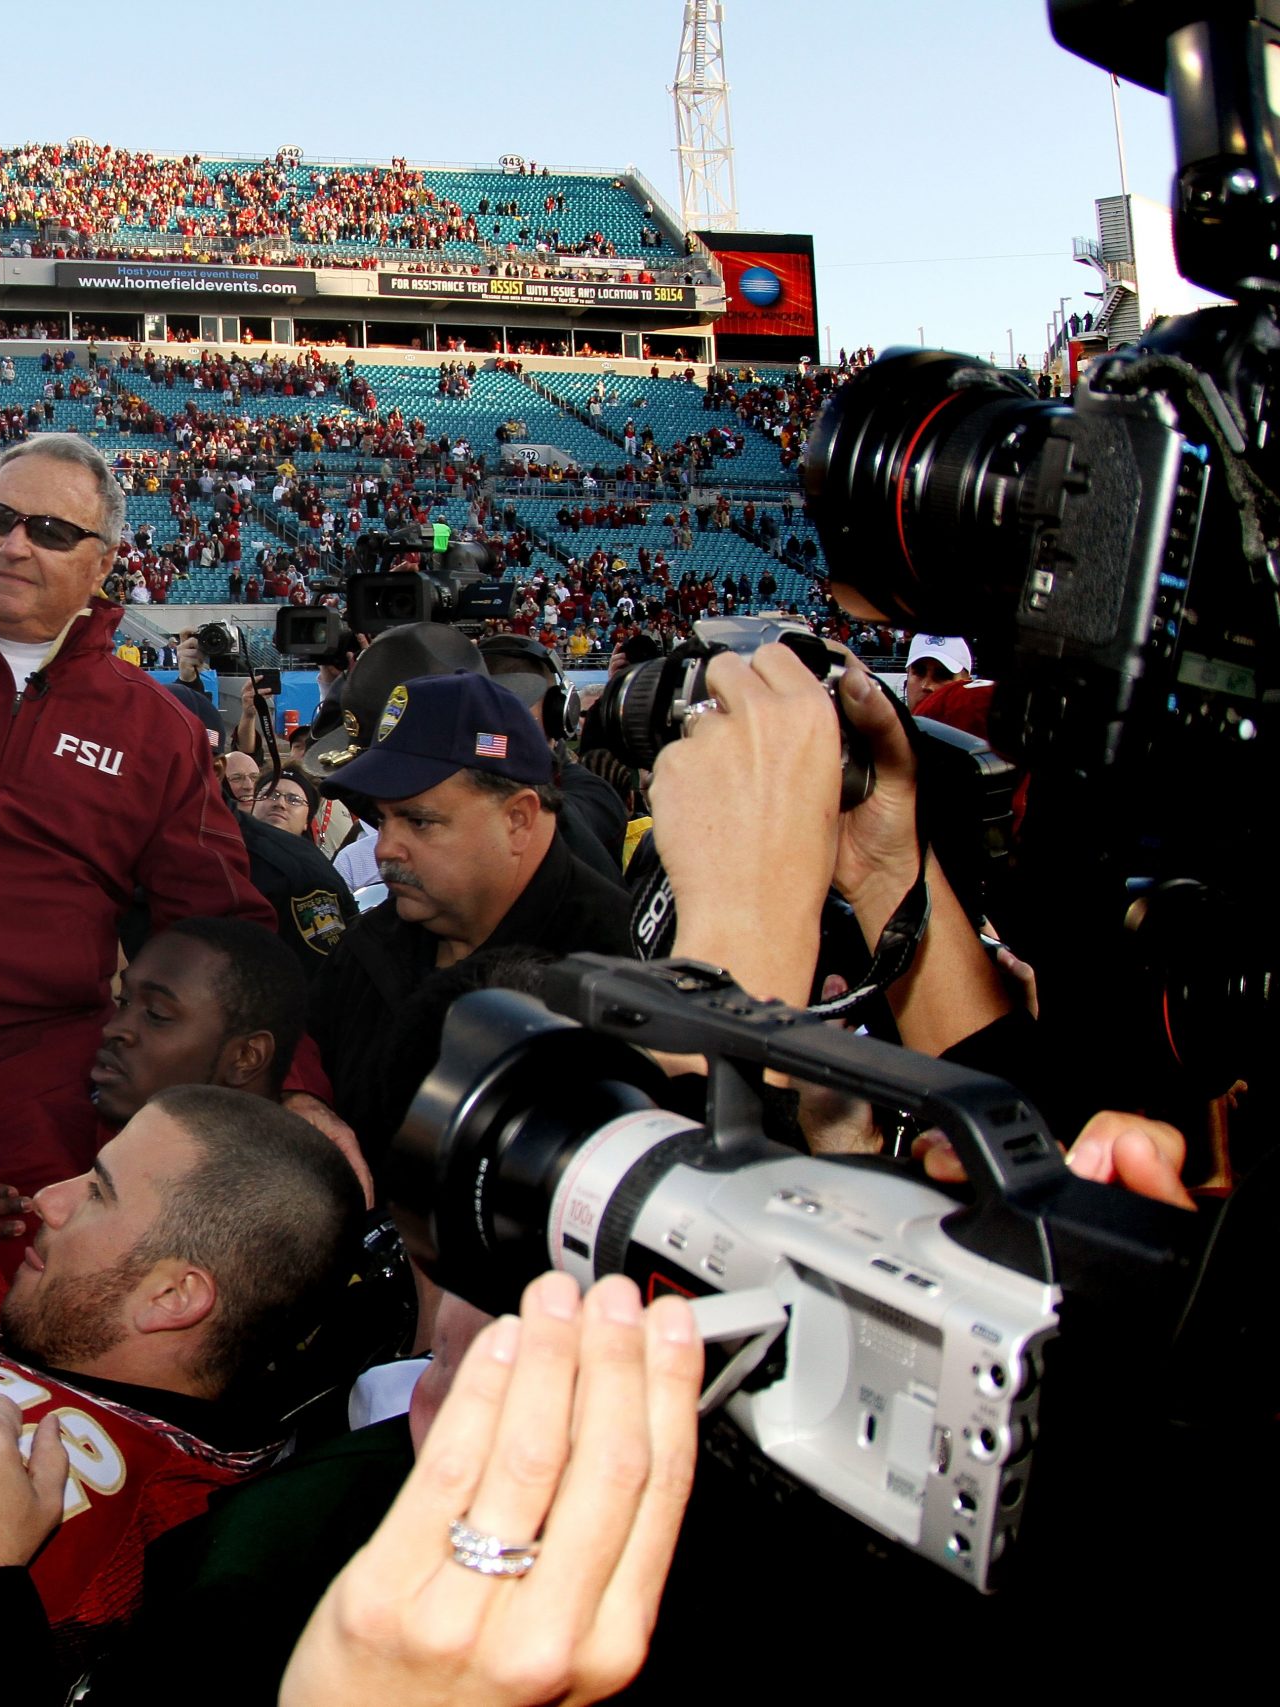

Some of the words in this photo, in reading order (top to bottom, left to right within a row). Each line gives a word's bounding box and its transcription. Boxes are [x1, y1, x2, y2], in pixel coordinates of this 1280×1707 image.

[281, 148, 300, 158] 442
[502, 157, 521, 166] 443
[117, 266, 143, 276] Host
[145, 268, 171, 280] your
[174, 269, 198, 278] next
[200, 271, 229, 279] event
[231, 271, 260, 281] here!
[78, 276, 298, 294] www.homefieldevents.com
[391, 278, 410, 290] FOR
[467, 282, 489, 293] TEXT
[490, 280, 524, 295] ASSIST
[525, 284, 549, 297] WITH
[550, 285, 576, 298] ISSUE
[577, 287, 596, 299] AND
[597, 288, 639, 300] LOCATION
[640, 290, 653, 301] TO
[654, 288, 684, 302] 58154
[520, 451, 536, 463] 242
[53, 732, 124, 776] FSU
[637, 876, 675, 945] EOS
